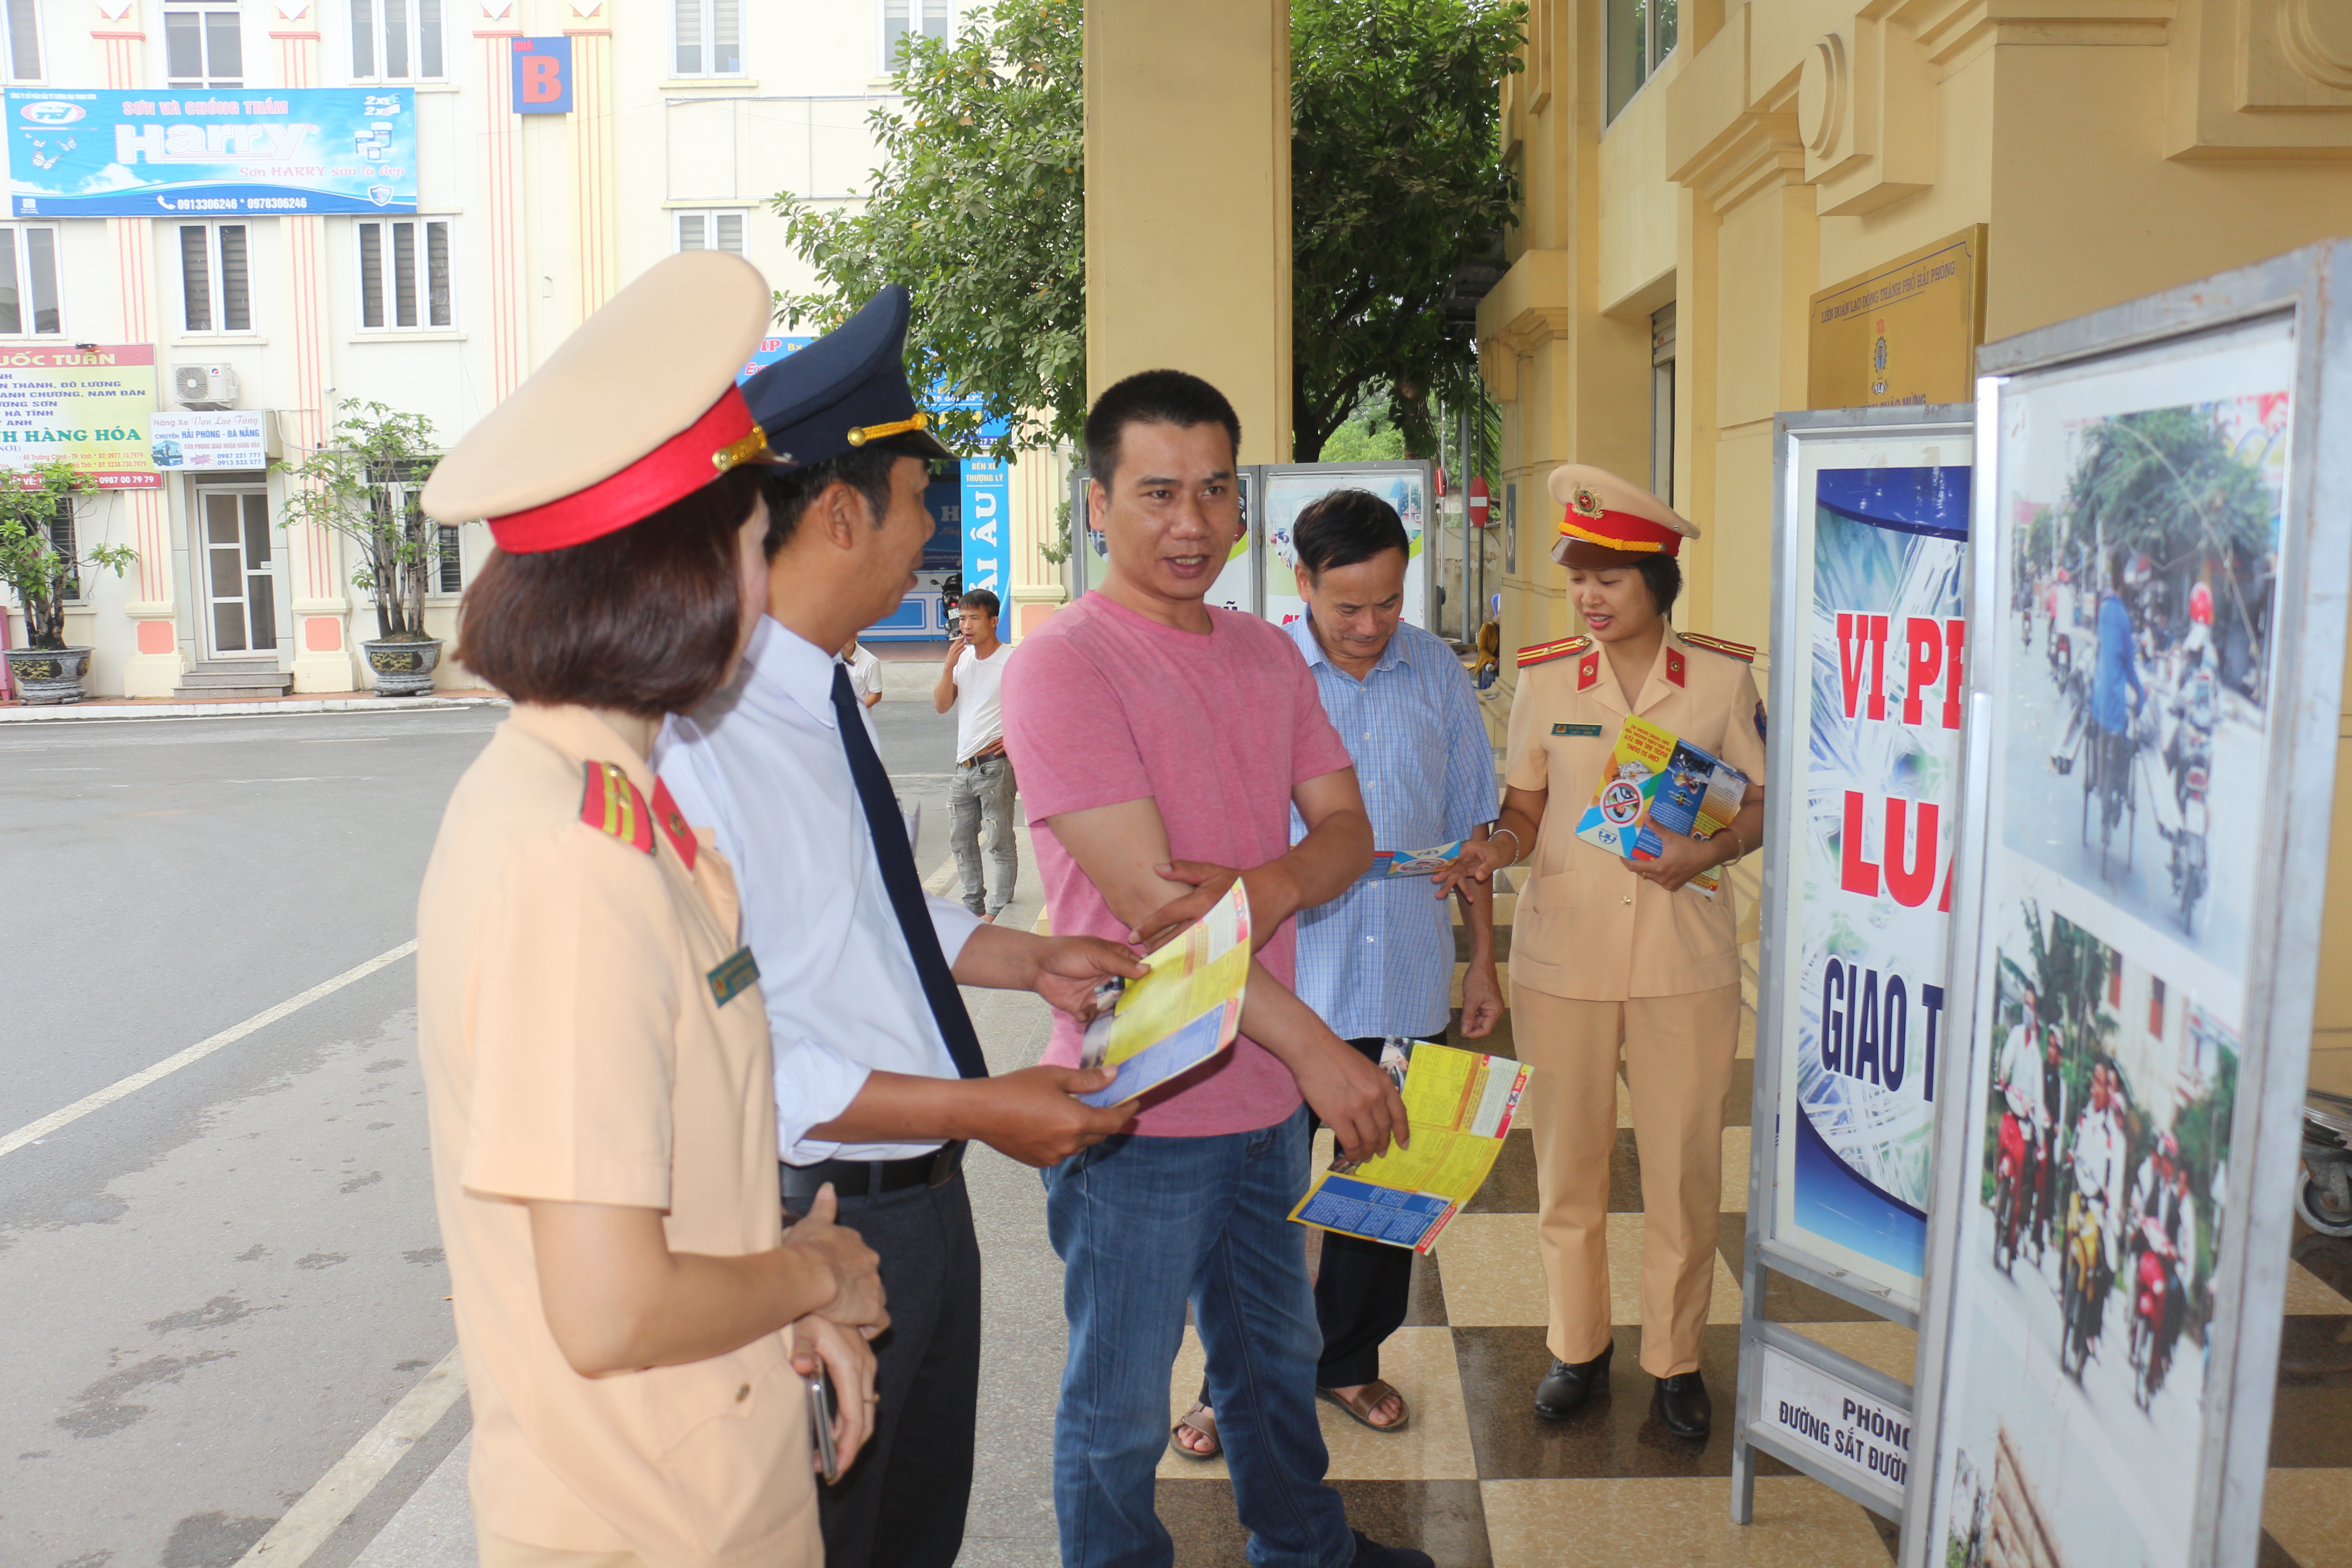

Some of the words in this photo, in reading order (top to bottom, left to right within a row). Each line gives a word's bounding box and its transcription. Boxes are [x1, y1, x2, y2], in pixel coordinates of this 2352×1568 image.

[514, 39, 534, 51] NHÀ
[522, 55, 562, 103] B
[122, 99, 155, 115] SƠN
[159, 99, 181, 115] VÀ
[185, 97, 240, 115] CHỐNG
[243, 97, 288, 115] THẤM
[115, 123, 306, 162] Harry
[240, 166, 266, 177] Sơn
[270, 166, 325, 177] HARRY
[331, 166, 356, 176] sơn
[361, 165, 375, 176] là
[379, 165, 405, 179] đẹp
[177, 198, 237, 210] 0913306246
[247, 197, 307, 209] 0978306246
[1821, 305, 1833, 323] LIÊN
[1834, 300, 1849, 318] ĐOÀN
[1850, 297, 1861, 313] LAO
[1862, 289, 1878, 310] ĐỘNG
[1880, 281, 1901, 302] THÀNH
[1903, 269, 1916, 293] PHỐ
[1917, 265, 1929, 288] HẢI
[1931, 260, 1955, 282] PHÒNG
[52, 350, 115, 365] TUẤN
[24, 427, 88, 442] HÀNG
[94, 425, 142, 441] HÓA
[181, 428, 194, 438] HẢI
[196, 428, 220, 438] PHÒNG
[227, 429, 237, 438] ĐÀ
[971, 461, 985, 470] BẾN
[965, 474, 994, 483] THƯỢNG
[995, 472, 1004, 482] LÝ
[970, 490, 997, 548] ÂU
[1836, 613, 1888, 721] VI
[1841, 790, 1953, 913] LU
[1822, 957, 1907, 1092] GIAO
[1779, 1400, 1830, 1446] ĐƯỜNG
[1834, 1426, 1864, 1463] SẮT
